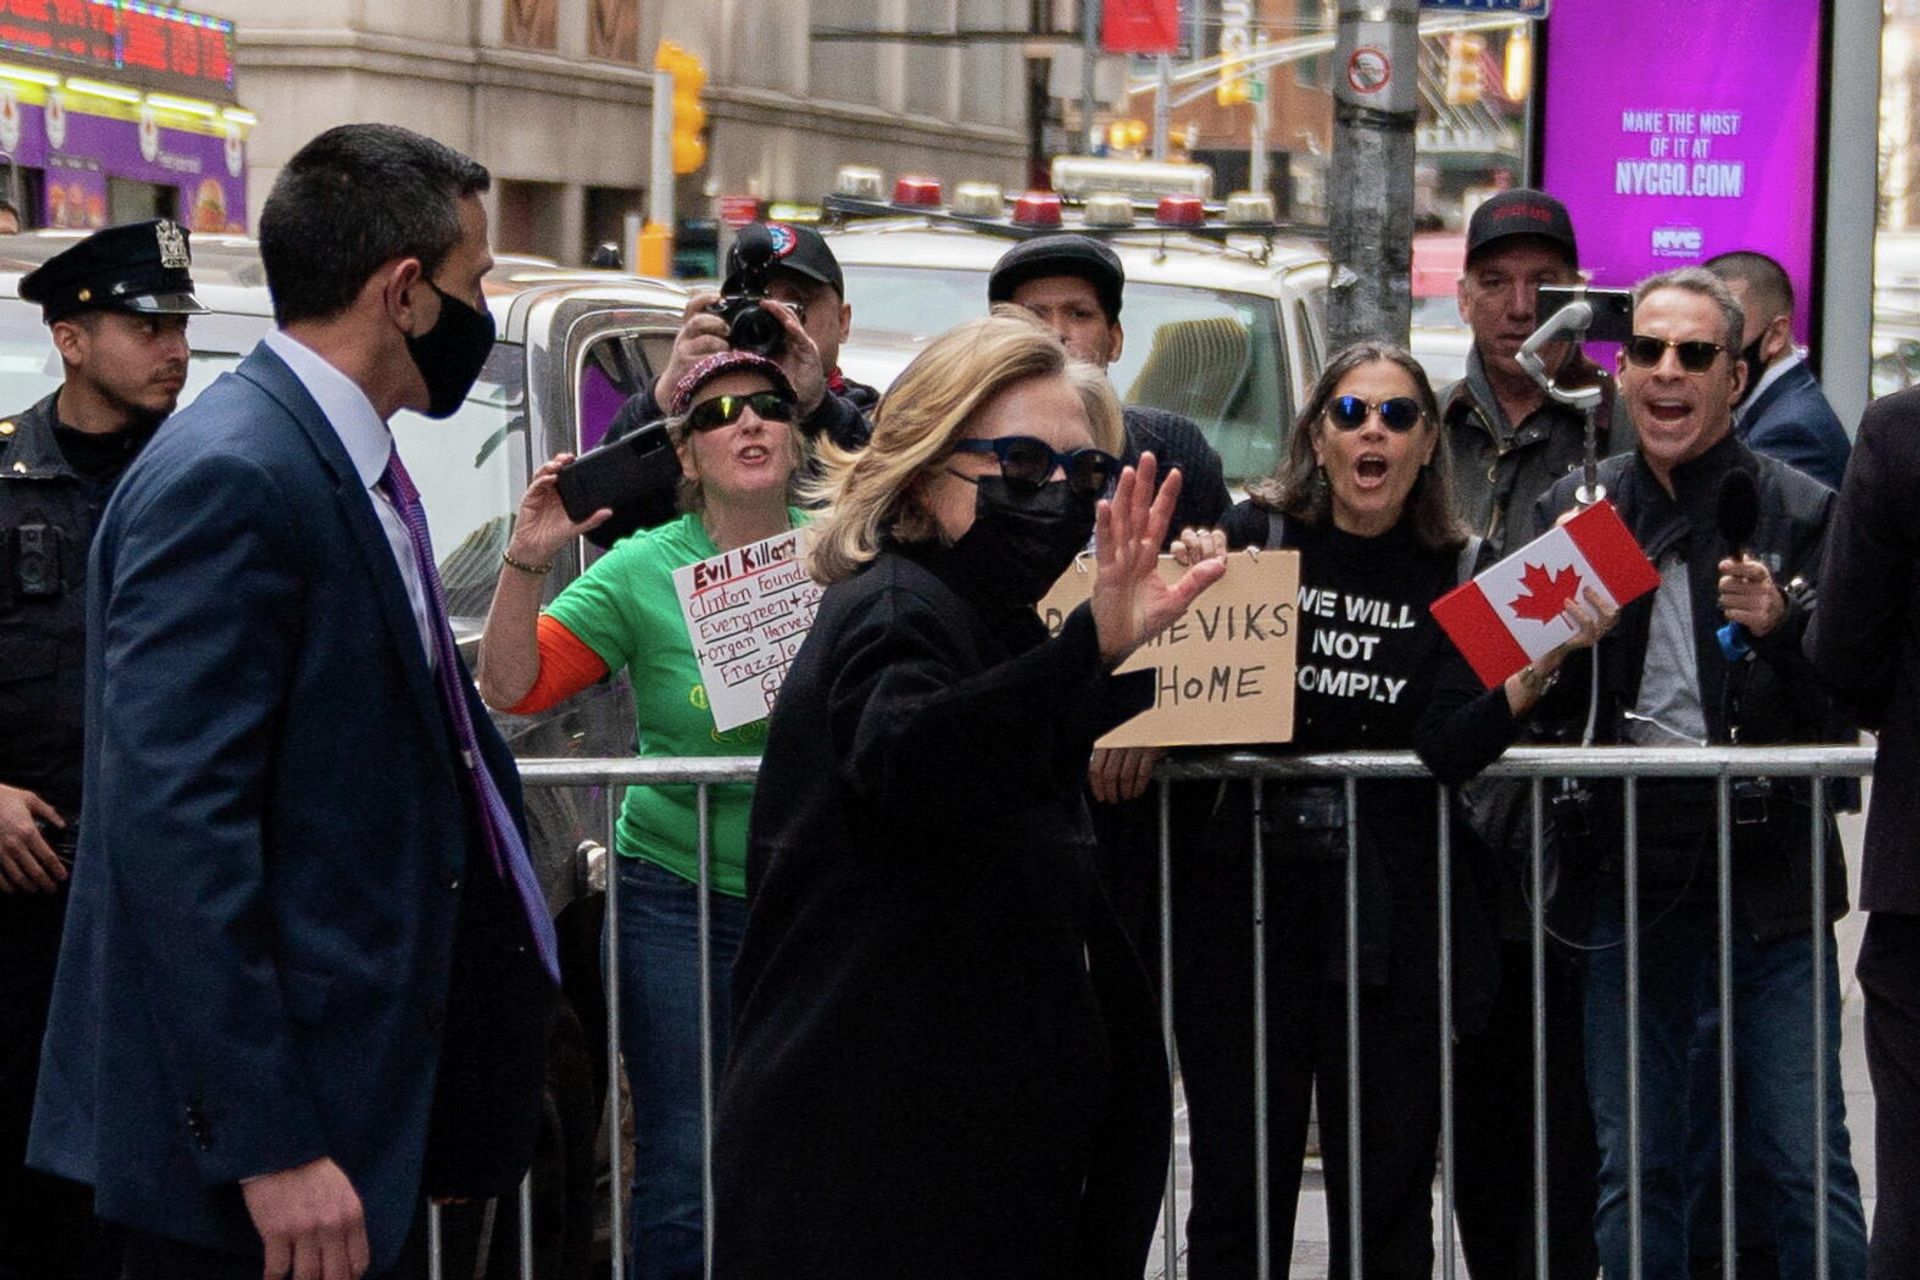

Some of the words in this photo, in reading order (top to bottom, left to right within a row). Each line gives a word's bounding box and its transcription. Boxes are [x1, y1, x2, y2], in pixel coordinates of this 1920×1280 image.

[1622, 112, 1661, 133] MAKE
[1667, 113, 1695, 134] THE
[1700, 114, 1740, 135] MOST
[1651, 137, 1669, 157] OF
[1673, 138, 1688, 158] IT
[1692, 138, 1710, 159] AT
[1616, 162, 1743, 197] NYCGO.COM
[693, 555, 732, 590] Evil
[741, 536, 797, 574] Killary
[689, 586, 752, 619] Clinton
[1297, 586, 1337, 617] WE
[1345, 595, 1415, 629] WILL
[1312, 628, 1380, 661] NOT
[1295, 665, 1408, 704] OMPLY
